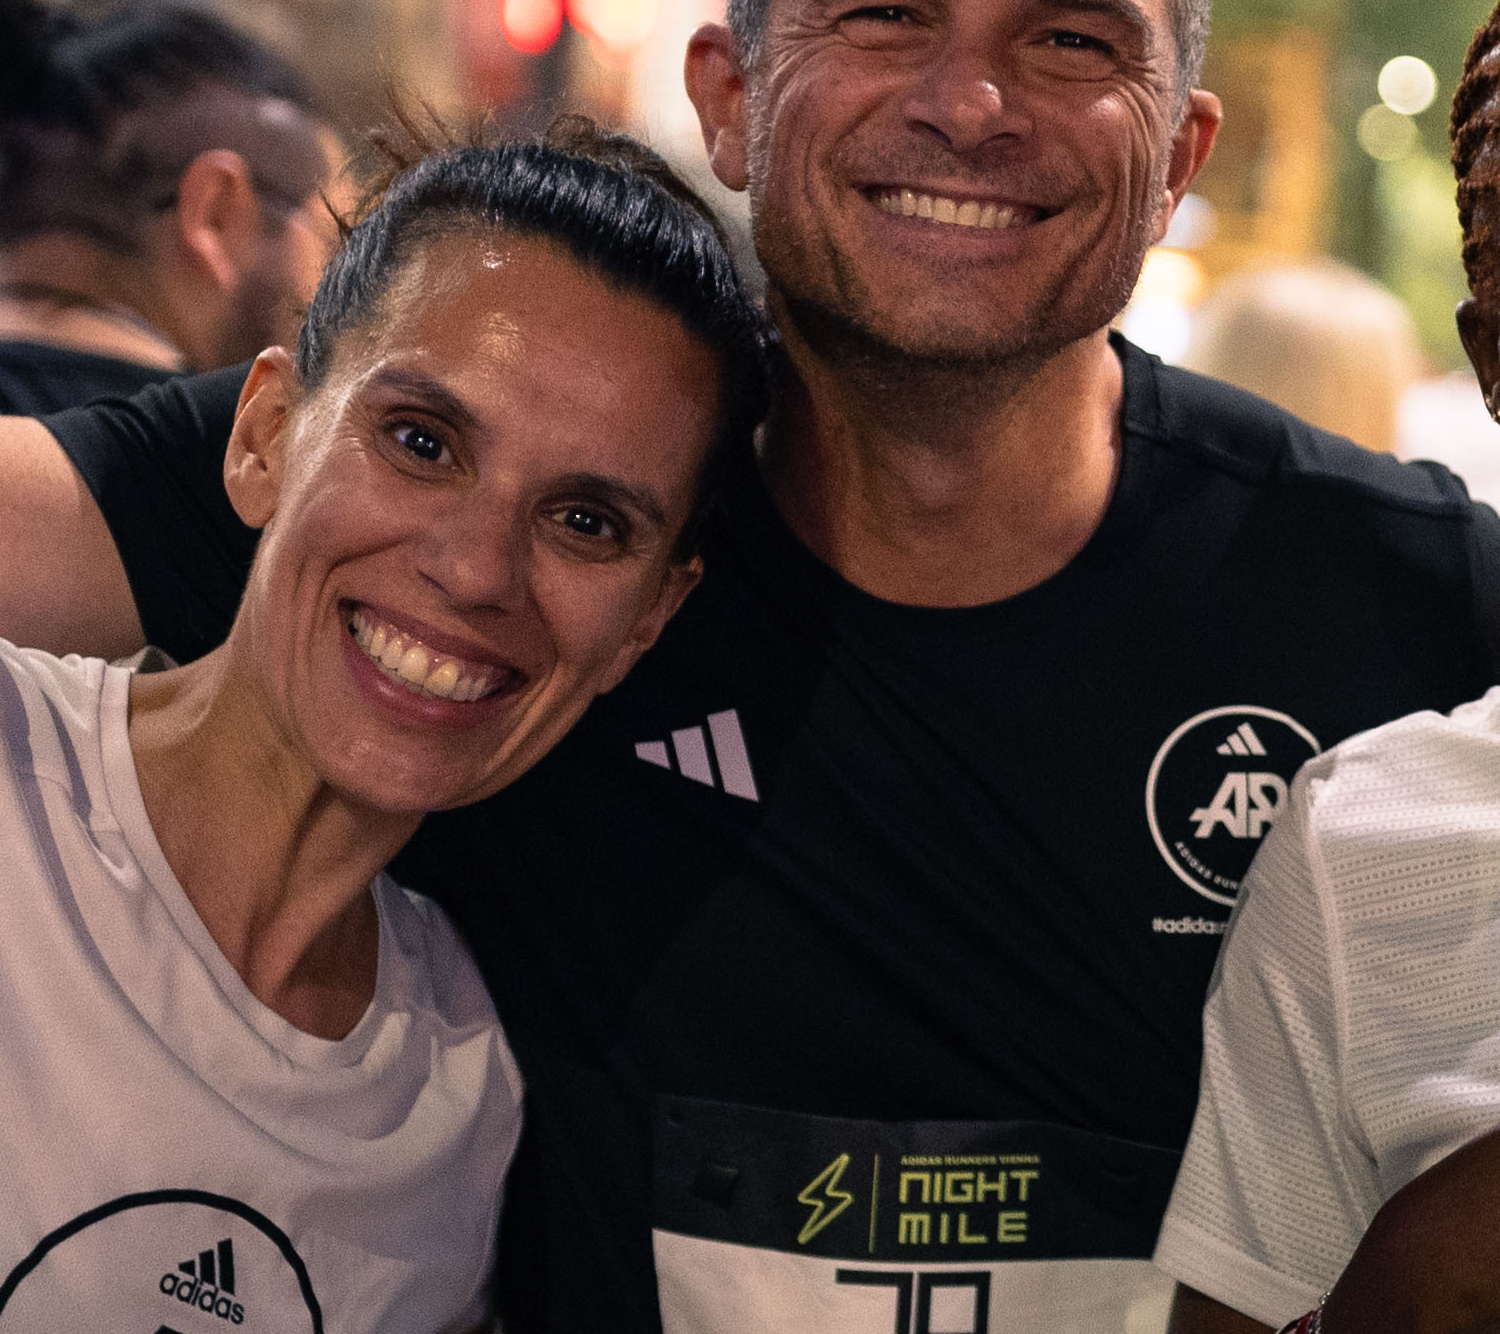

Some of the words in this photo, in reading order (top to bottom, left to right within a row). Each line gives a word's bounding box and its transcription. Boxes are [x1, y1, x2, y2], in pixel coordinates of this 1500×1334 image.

[1213, 874, 1239, 890] RUN
[898, 1170, 1040, 1204] NIGHT
[898, 1210, 1029, 1245] MILE
[160, 1270, 245, 1324] adidas
